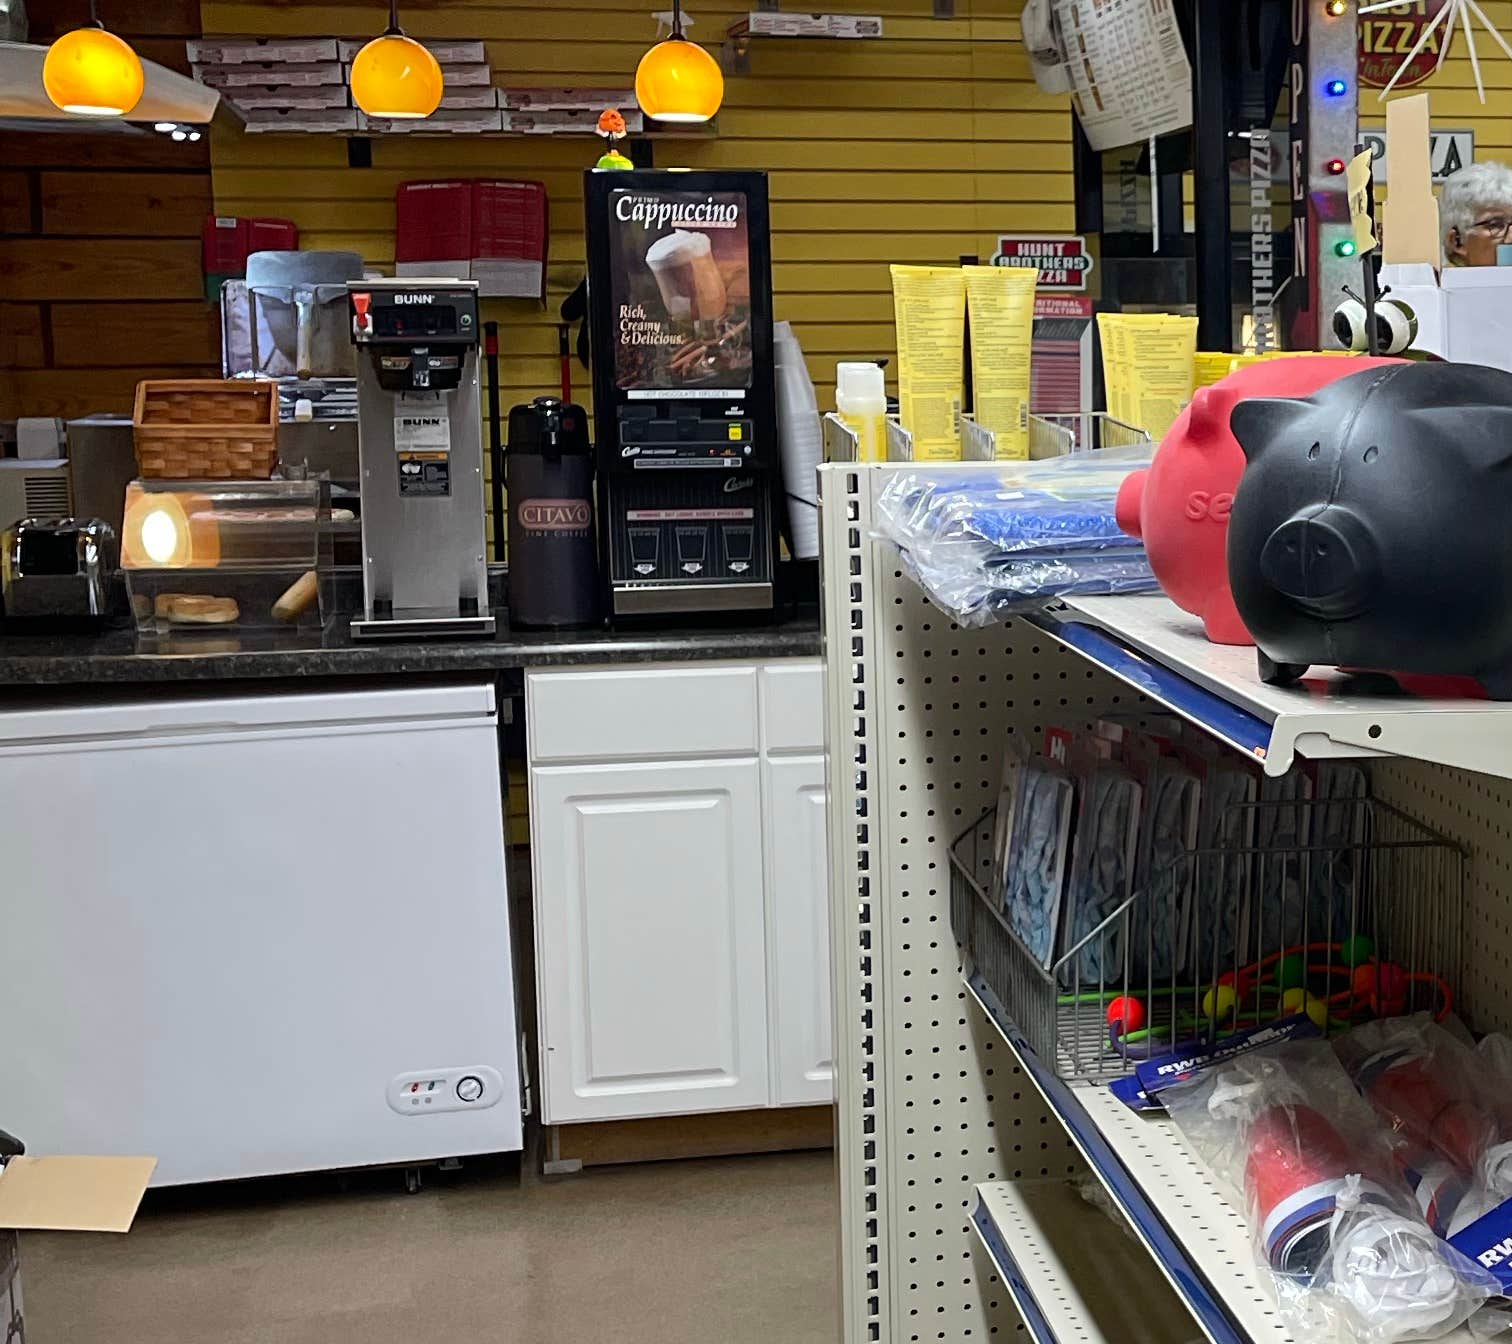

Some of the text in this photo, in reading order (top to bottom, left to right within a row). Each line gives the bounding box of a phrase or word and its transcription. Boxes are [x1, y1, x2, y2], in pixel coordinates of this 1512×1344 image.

[1358, 20, 1439, 54] IZZA
[616, 196, 738, 229] Cappuccino
[1017, 243, 1065, 256] HUNT
[1037, 270, 1067, 283] ZZA
[394, 294, 433, 305] BUNN
[619, 304, 647, 320] Rich,
[619, 318, 661, 335] Creamy
[402, 419, 441, 427] BUNN
[522, 505, 588, 523] CITAVO
